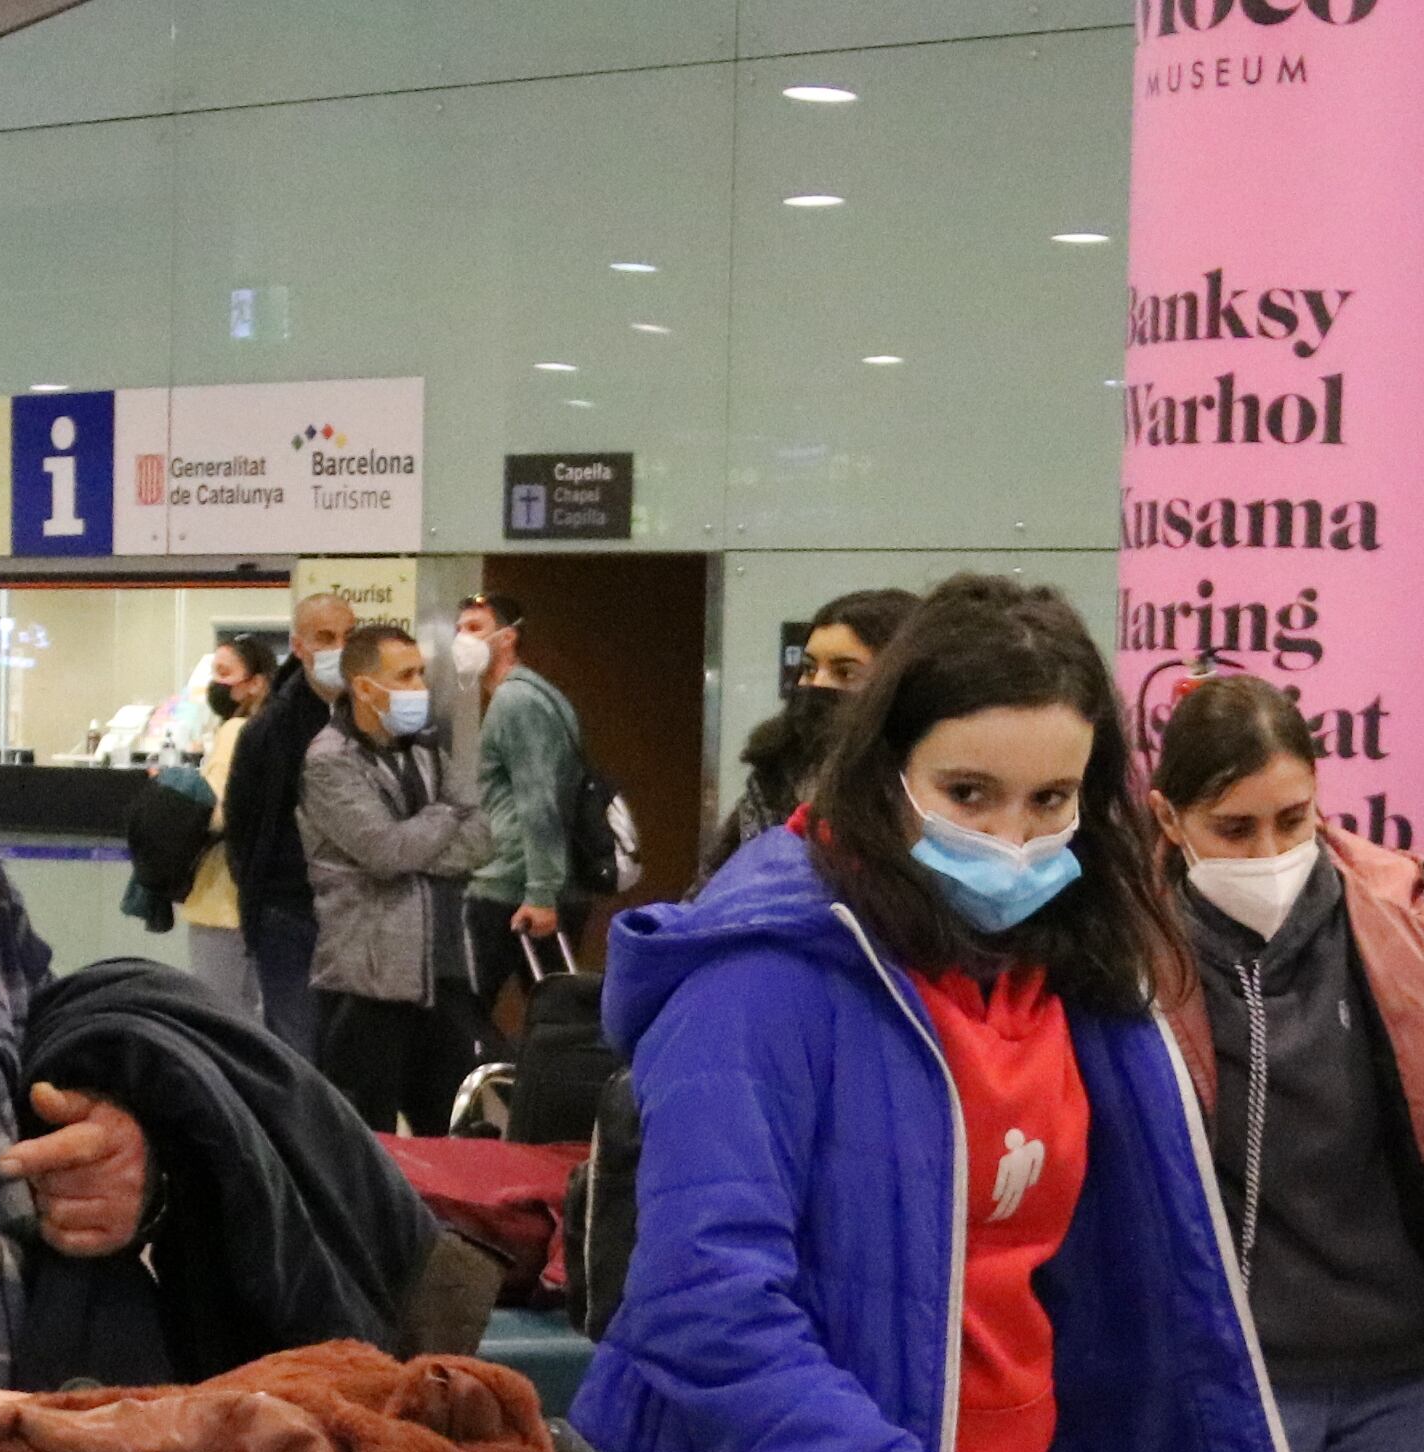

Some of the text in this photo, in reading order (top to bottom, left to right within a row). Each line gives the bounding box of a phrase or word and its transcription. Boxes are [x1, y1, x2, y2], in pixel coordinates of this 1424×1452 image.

[1146, 54, 1307, 97] MUSEUM
[170, 456, 266, 478] Generalitat
[311, 449, 415, 476] Barcelona
[554, 462, 613, 485] Capella
[170, 484, 284, 508] de Catalunya
[312, 485, 392, 510] Turisme
[331, 584, 392, 603] Tourist
